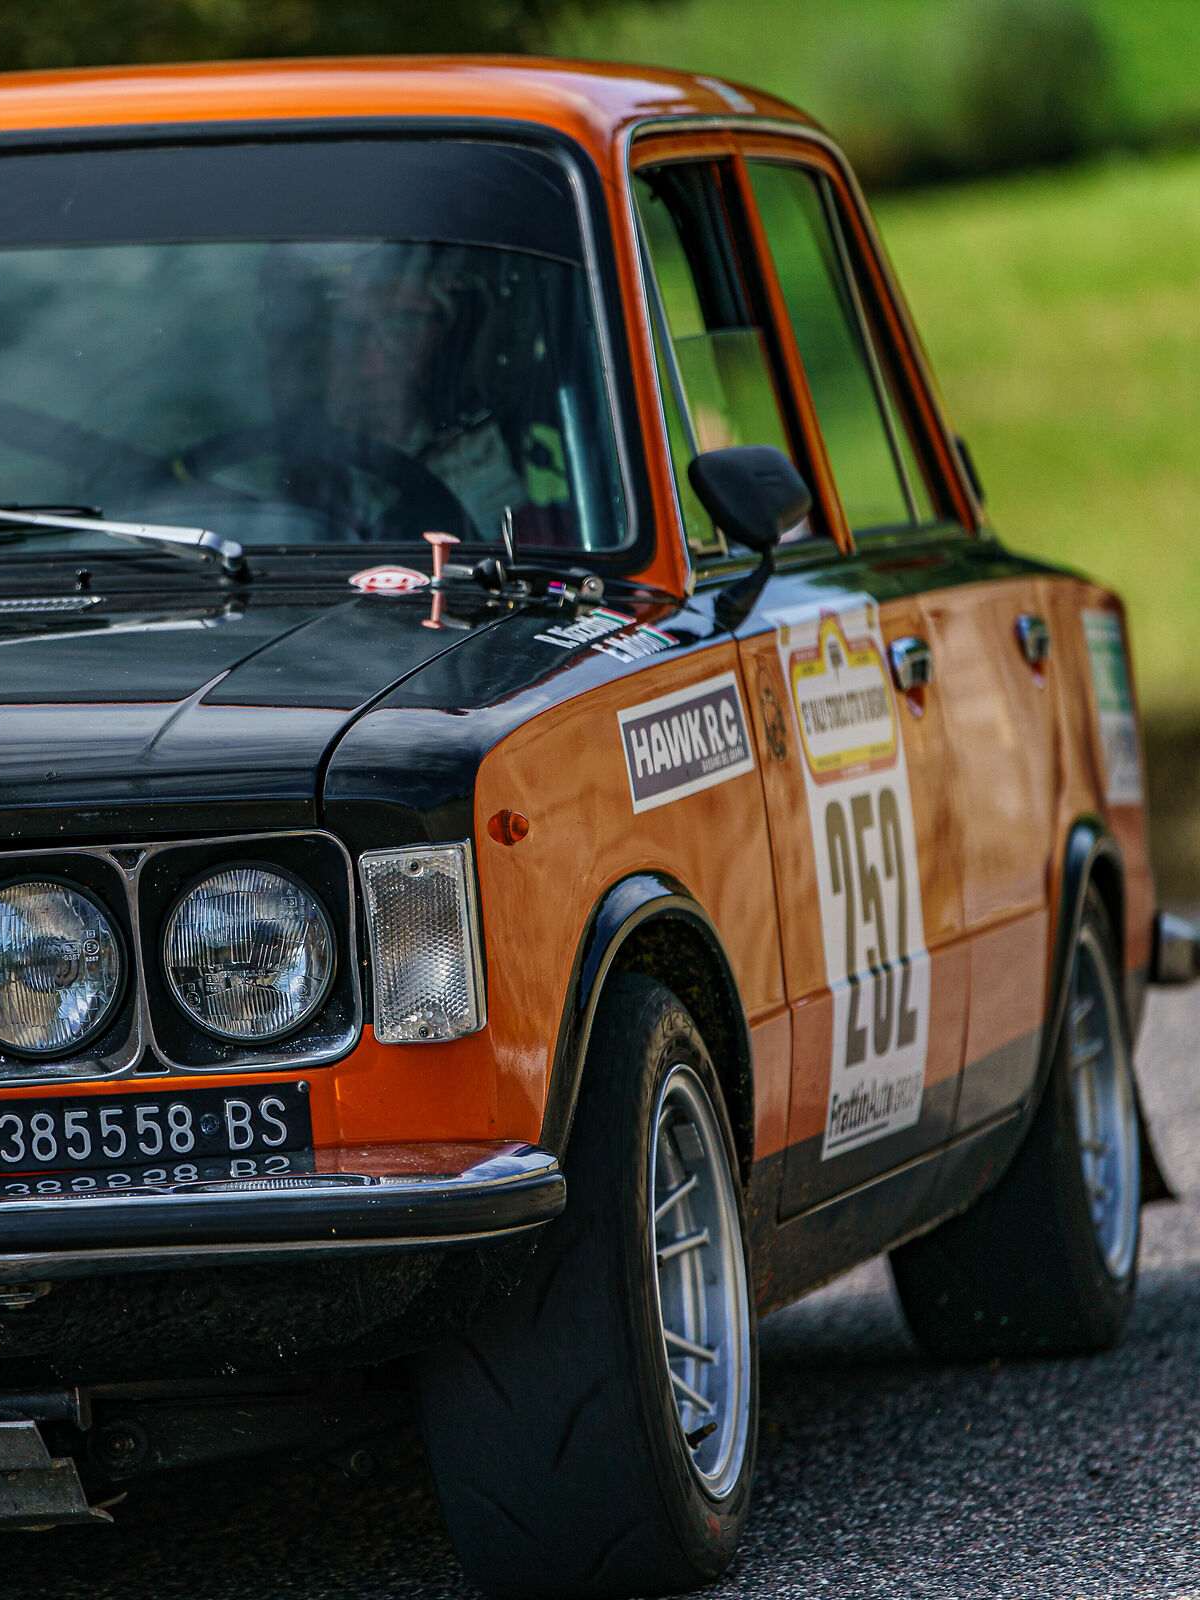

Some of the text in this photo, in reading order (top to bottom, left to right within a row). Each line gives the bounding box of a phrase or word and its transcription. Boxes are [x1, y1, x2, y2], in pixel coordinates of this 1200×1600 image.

[630, 707, 709, 779] HAWK
[825, 785, 918, 1069] 252
[223, 1096, 288, 1152] BS
